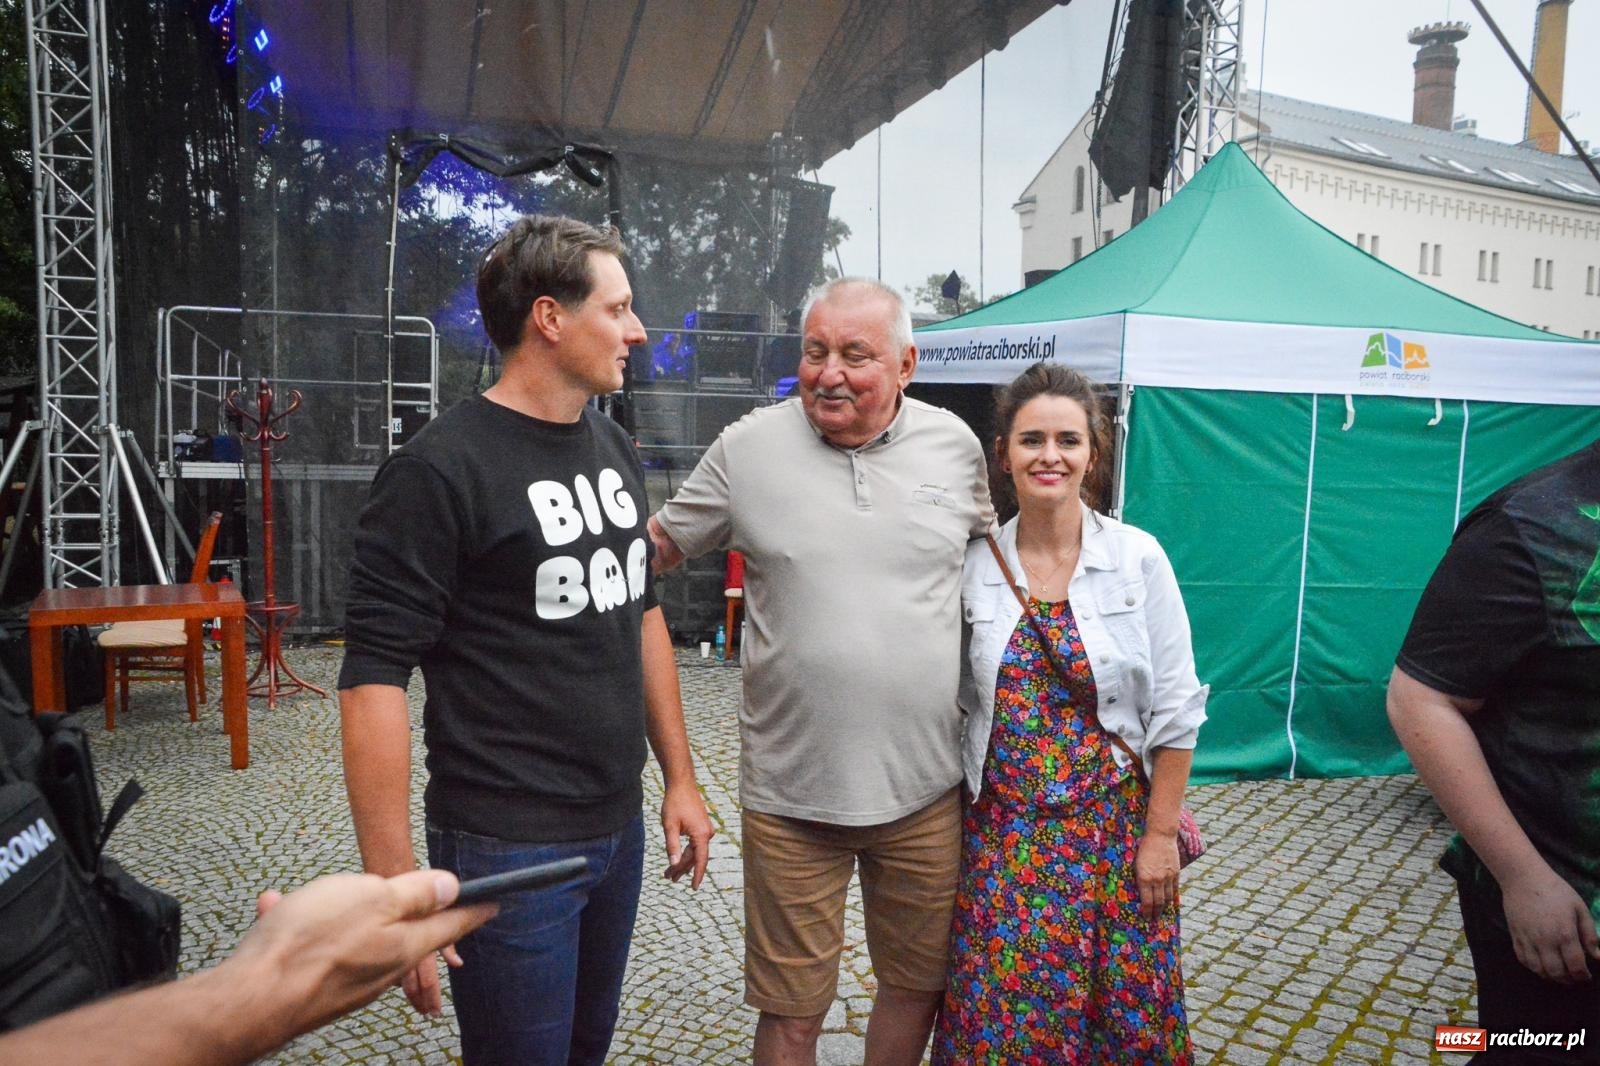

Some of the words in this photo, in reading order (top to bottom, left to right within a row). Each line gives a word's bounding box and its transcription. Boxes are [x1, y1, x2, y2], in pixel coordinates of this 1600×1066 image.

[919, 335, 1056, 365] www.powiatraciborski.pl
[1360, 371, 1387, 380] powiat
[527, 468, 638, 546] BIG
[0, 817, 56, 886] RONA
